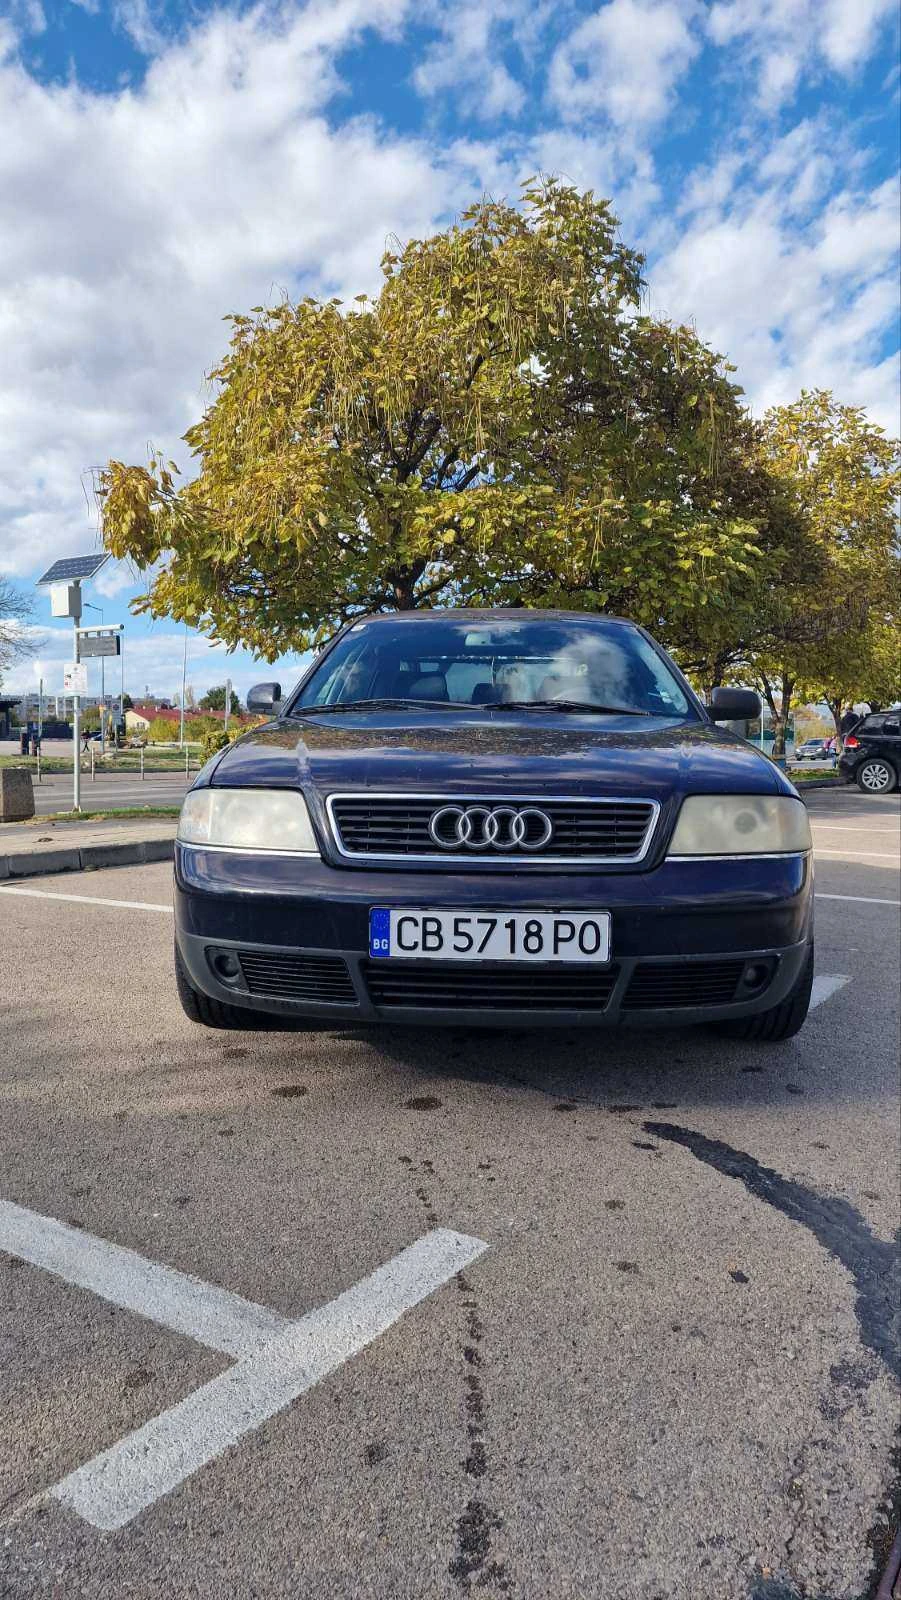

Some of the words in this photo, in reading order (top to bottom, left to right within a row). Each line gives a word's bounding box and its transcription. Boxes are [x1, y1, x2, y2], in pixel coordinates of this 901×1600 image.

[373, 938, 389, 950] BG
[396, 916, 444, 952] CB
[453, 918, 544, 954] 5718
